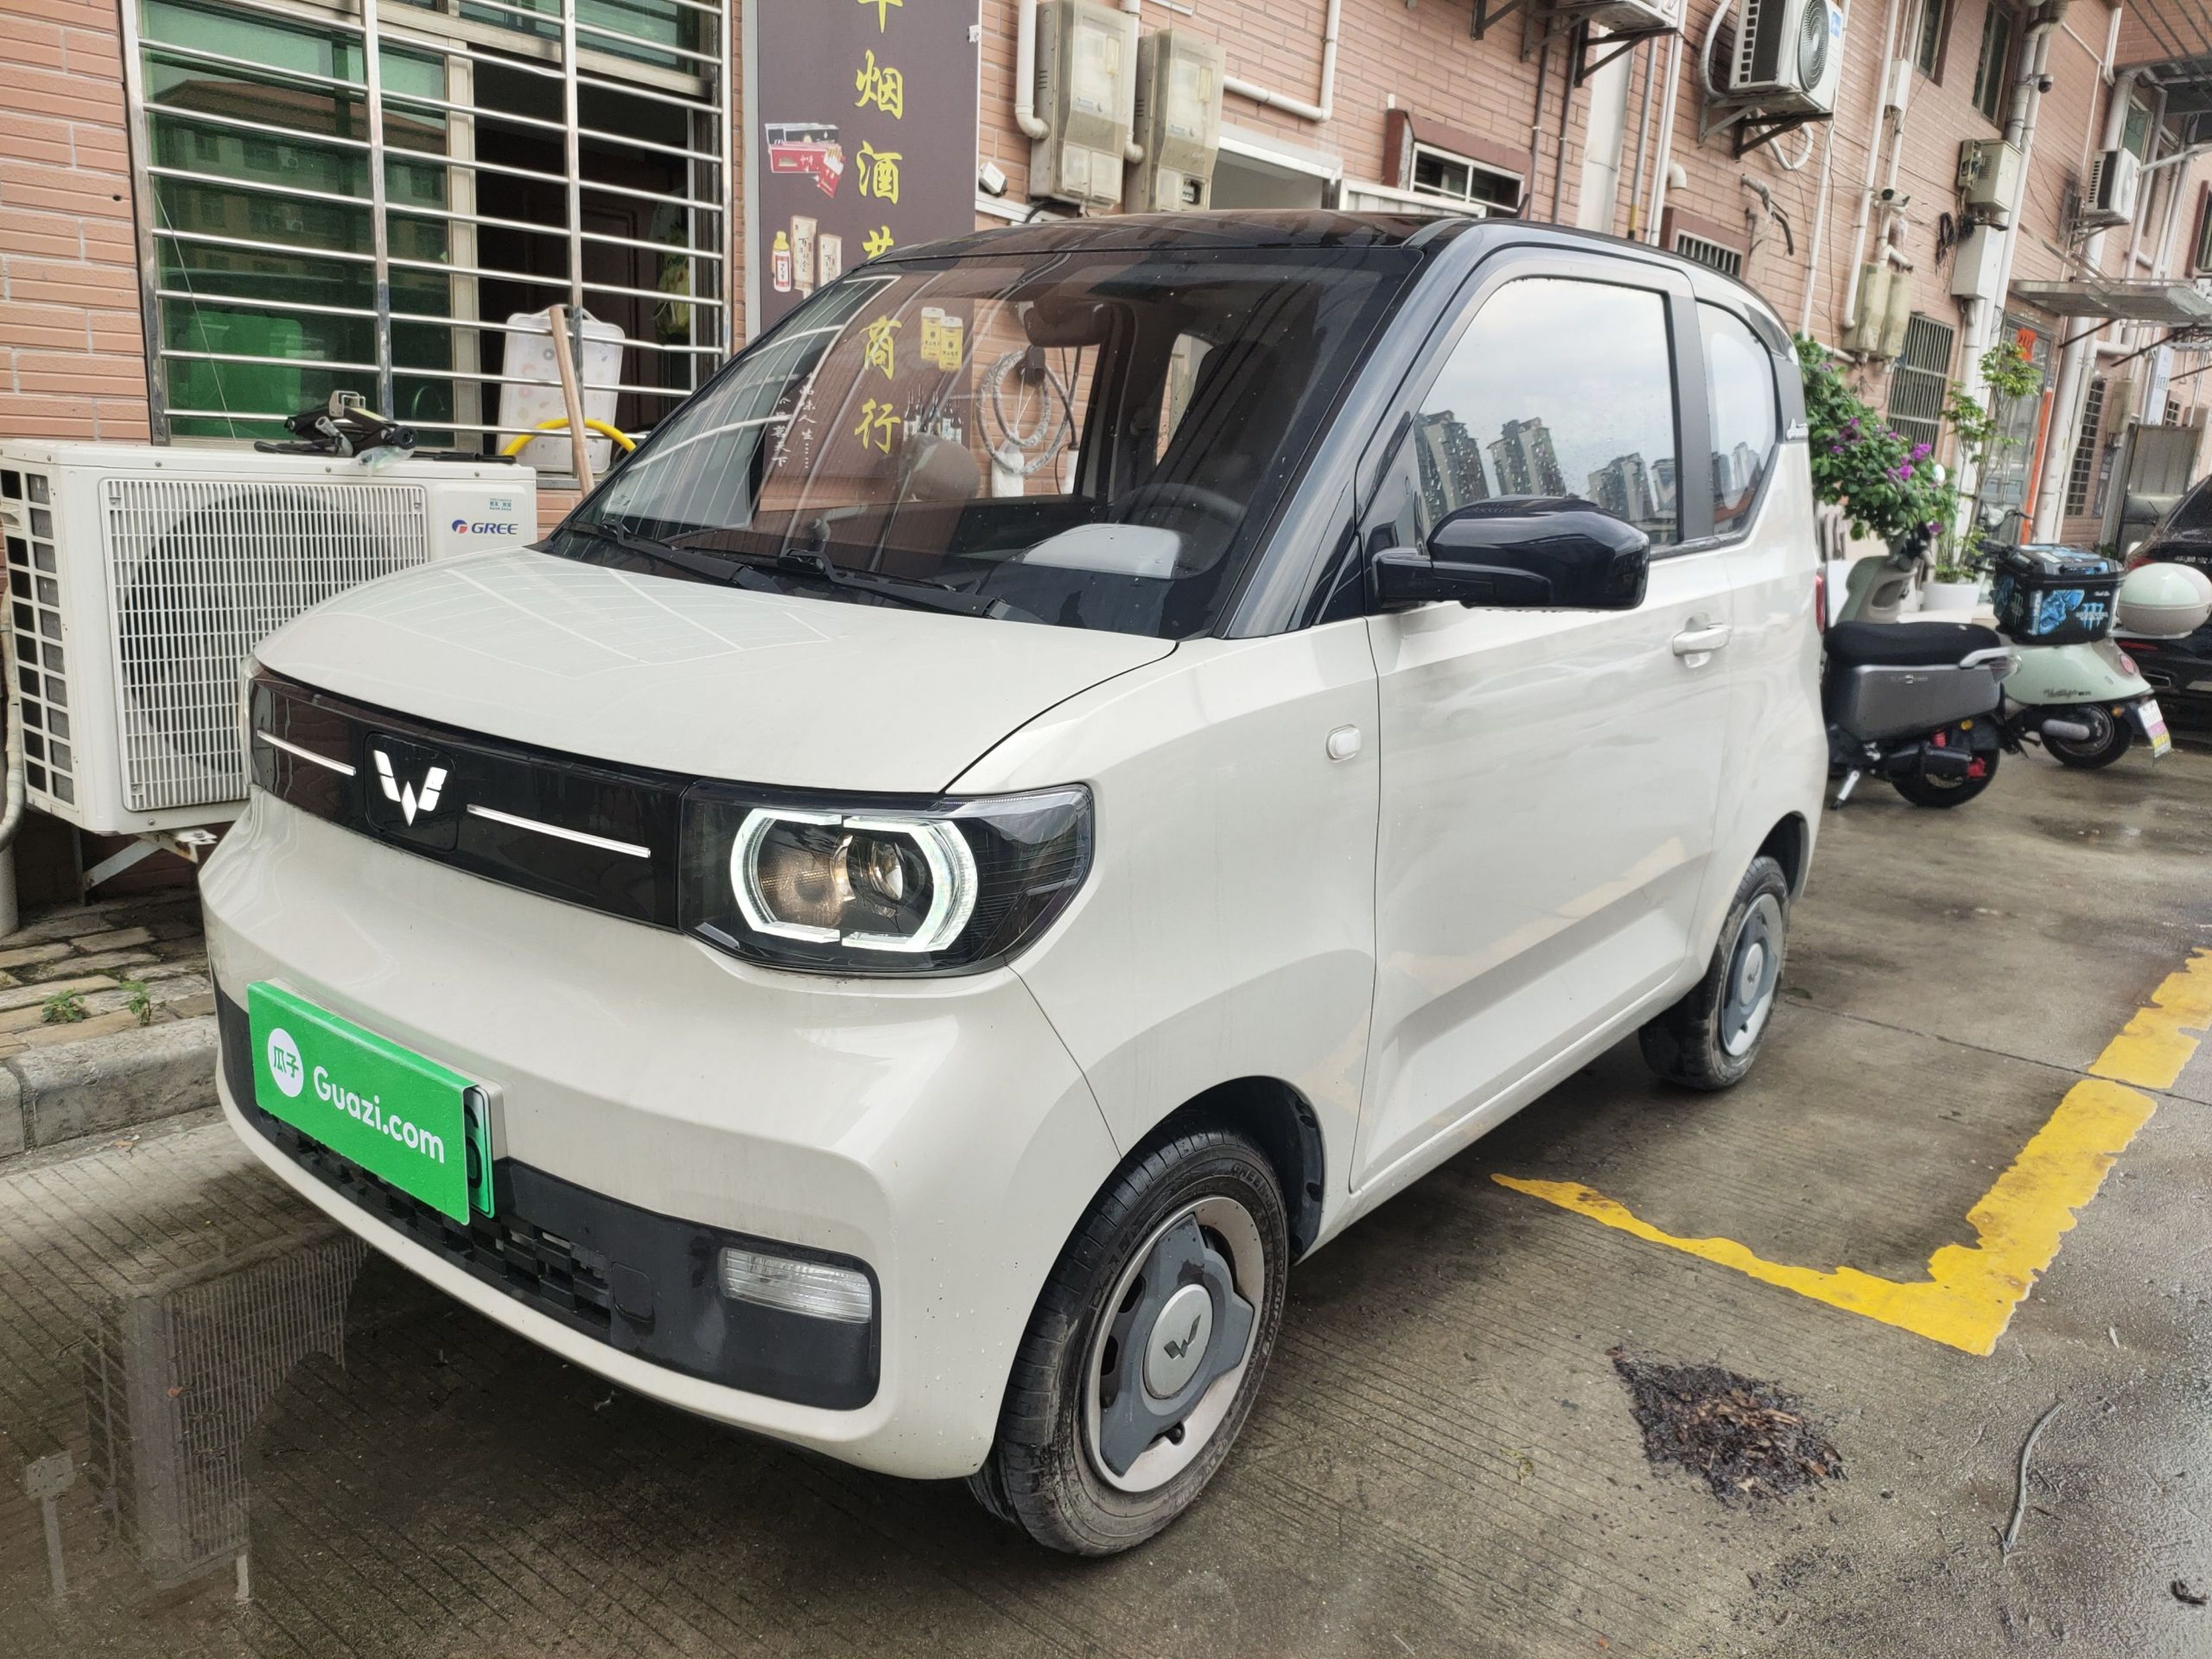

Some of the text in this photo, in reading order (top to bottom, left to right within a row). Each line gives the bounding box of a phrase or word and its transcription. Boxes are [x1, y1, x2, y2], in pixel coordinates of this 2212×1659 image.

[471, 522, 519, 535] GREE
[273, 1046, 300, 1078] 瓜子
[313, 1066, 445, 1164] Guazi.com
